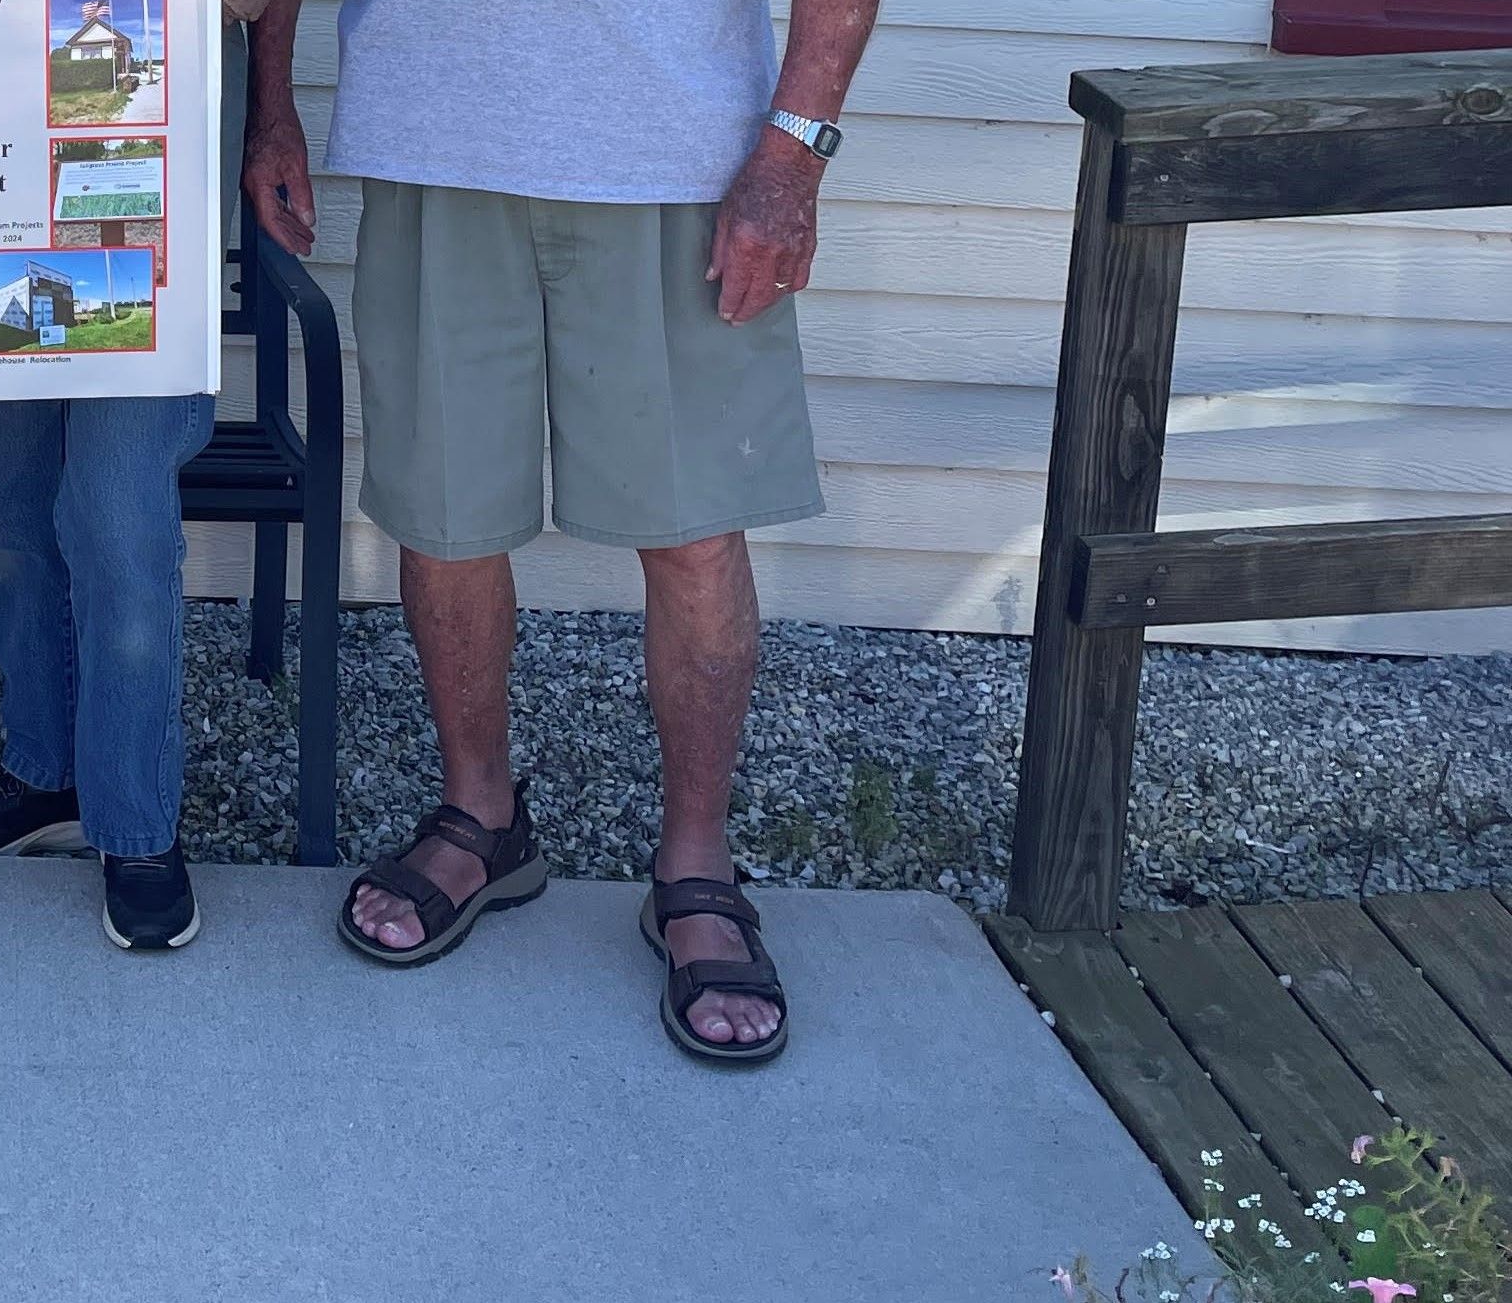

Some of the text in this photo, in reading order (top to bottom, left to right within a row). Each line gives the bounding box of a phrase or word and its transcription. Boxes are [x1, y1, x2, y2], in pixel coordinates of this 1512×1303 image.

[11, 221, 44, 230] Projects
[2, 235, 23, 243] 2024
[29, 355, 72, 364] Relocation
